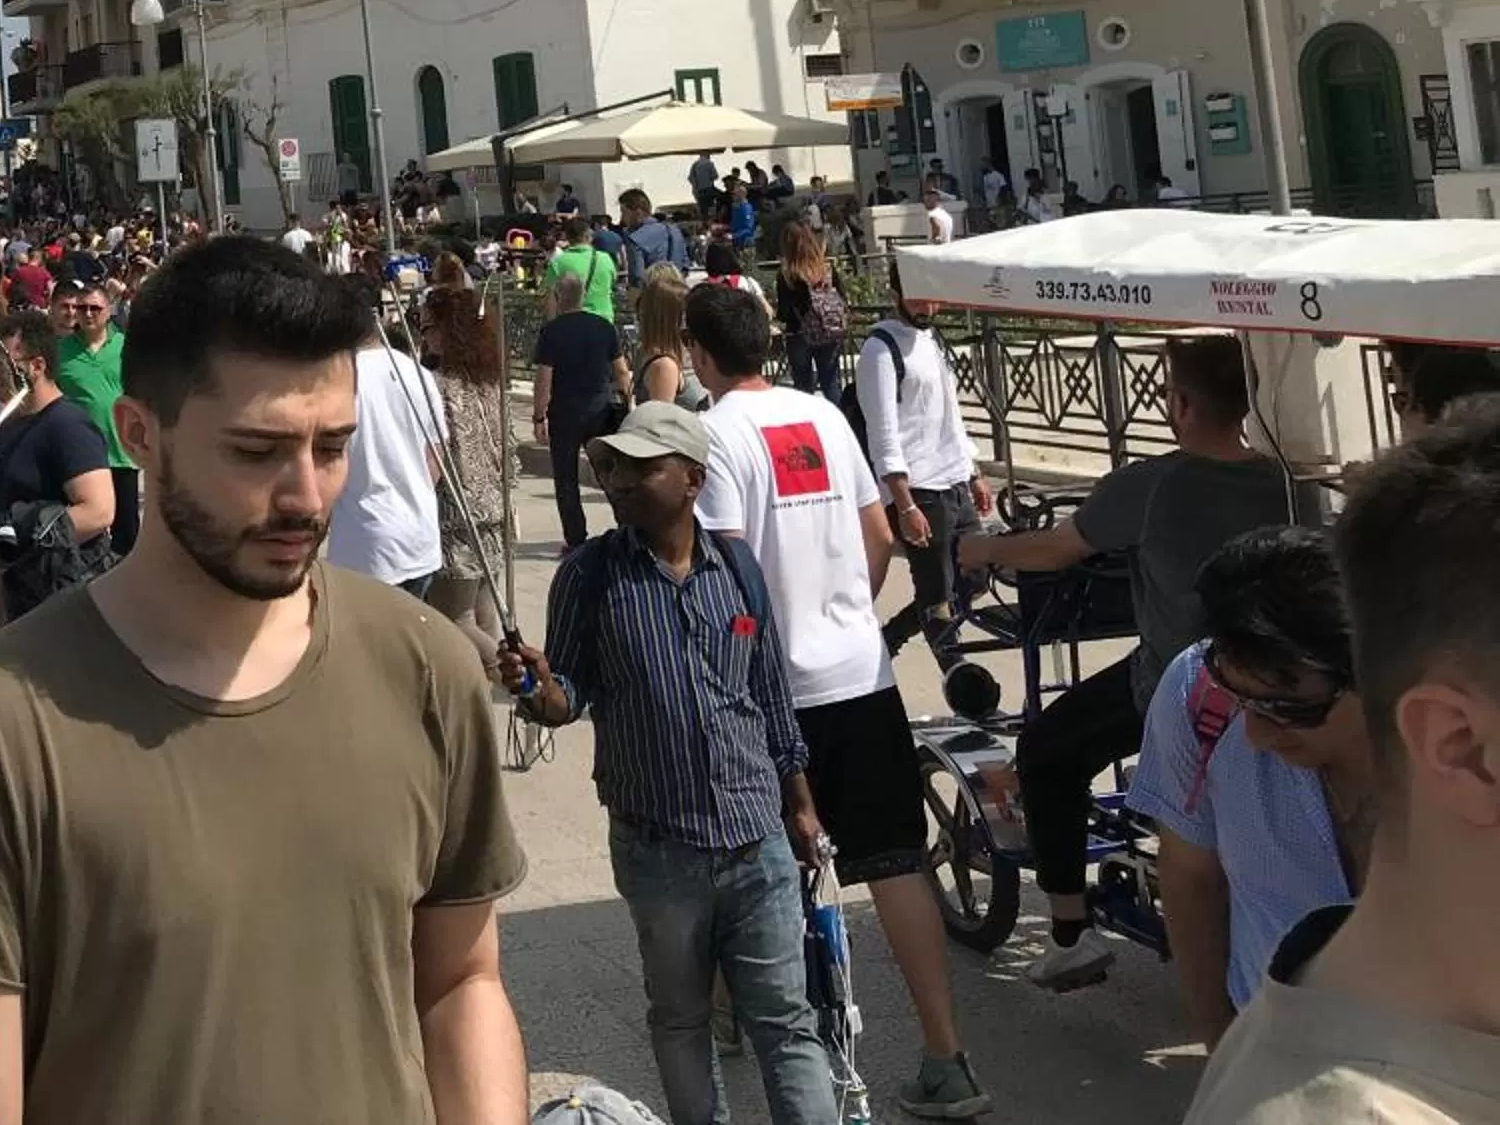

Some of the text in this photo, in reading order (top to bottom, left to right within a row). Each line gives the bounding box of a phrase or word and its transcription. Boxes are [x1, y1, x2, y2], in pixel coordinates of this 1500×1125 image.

[1034, 279, 1152, 305] 339.73.43.010
[1209, 280, 1277, 297] NOLEGGIO
[1216, 299, 1273, 316] RENTAL
[1300, 281, 1323, 321] 8
